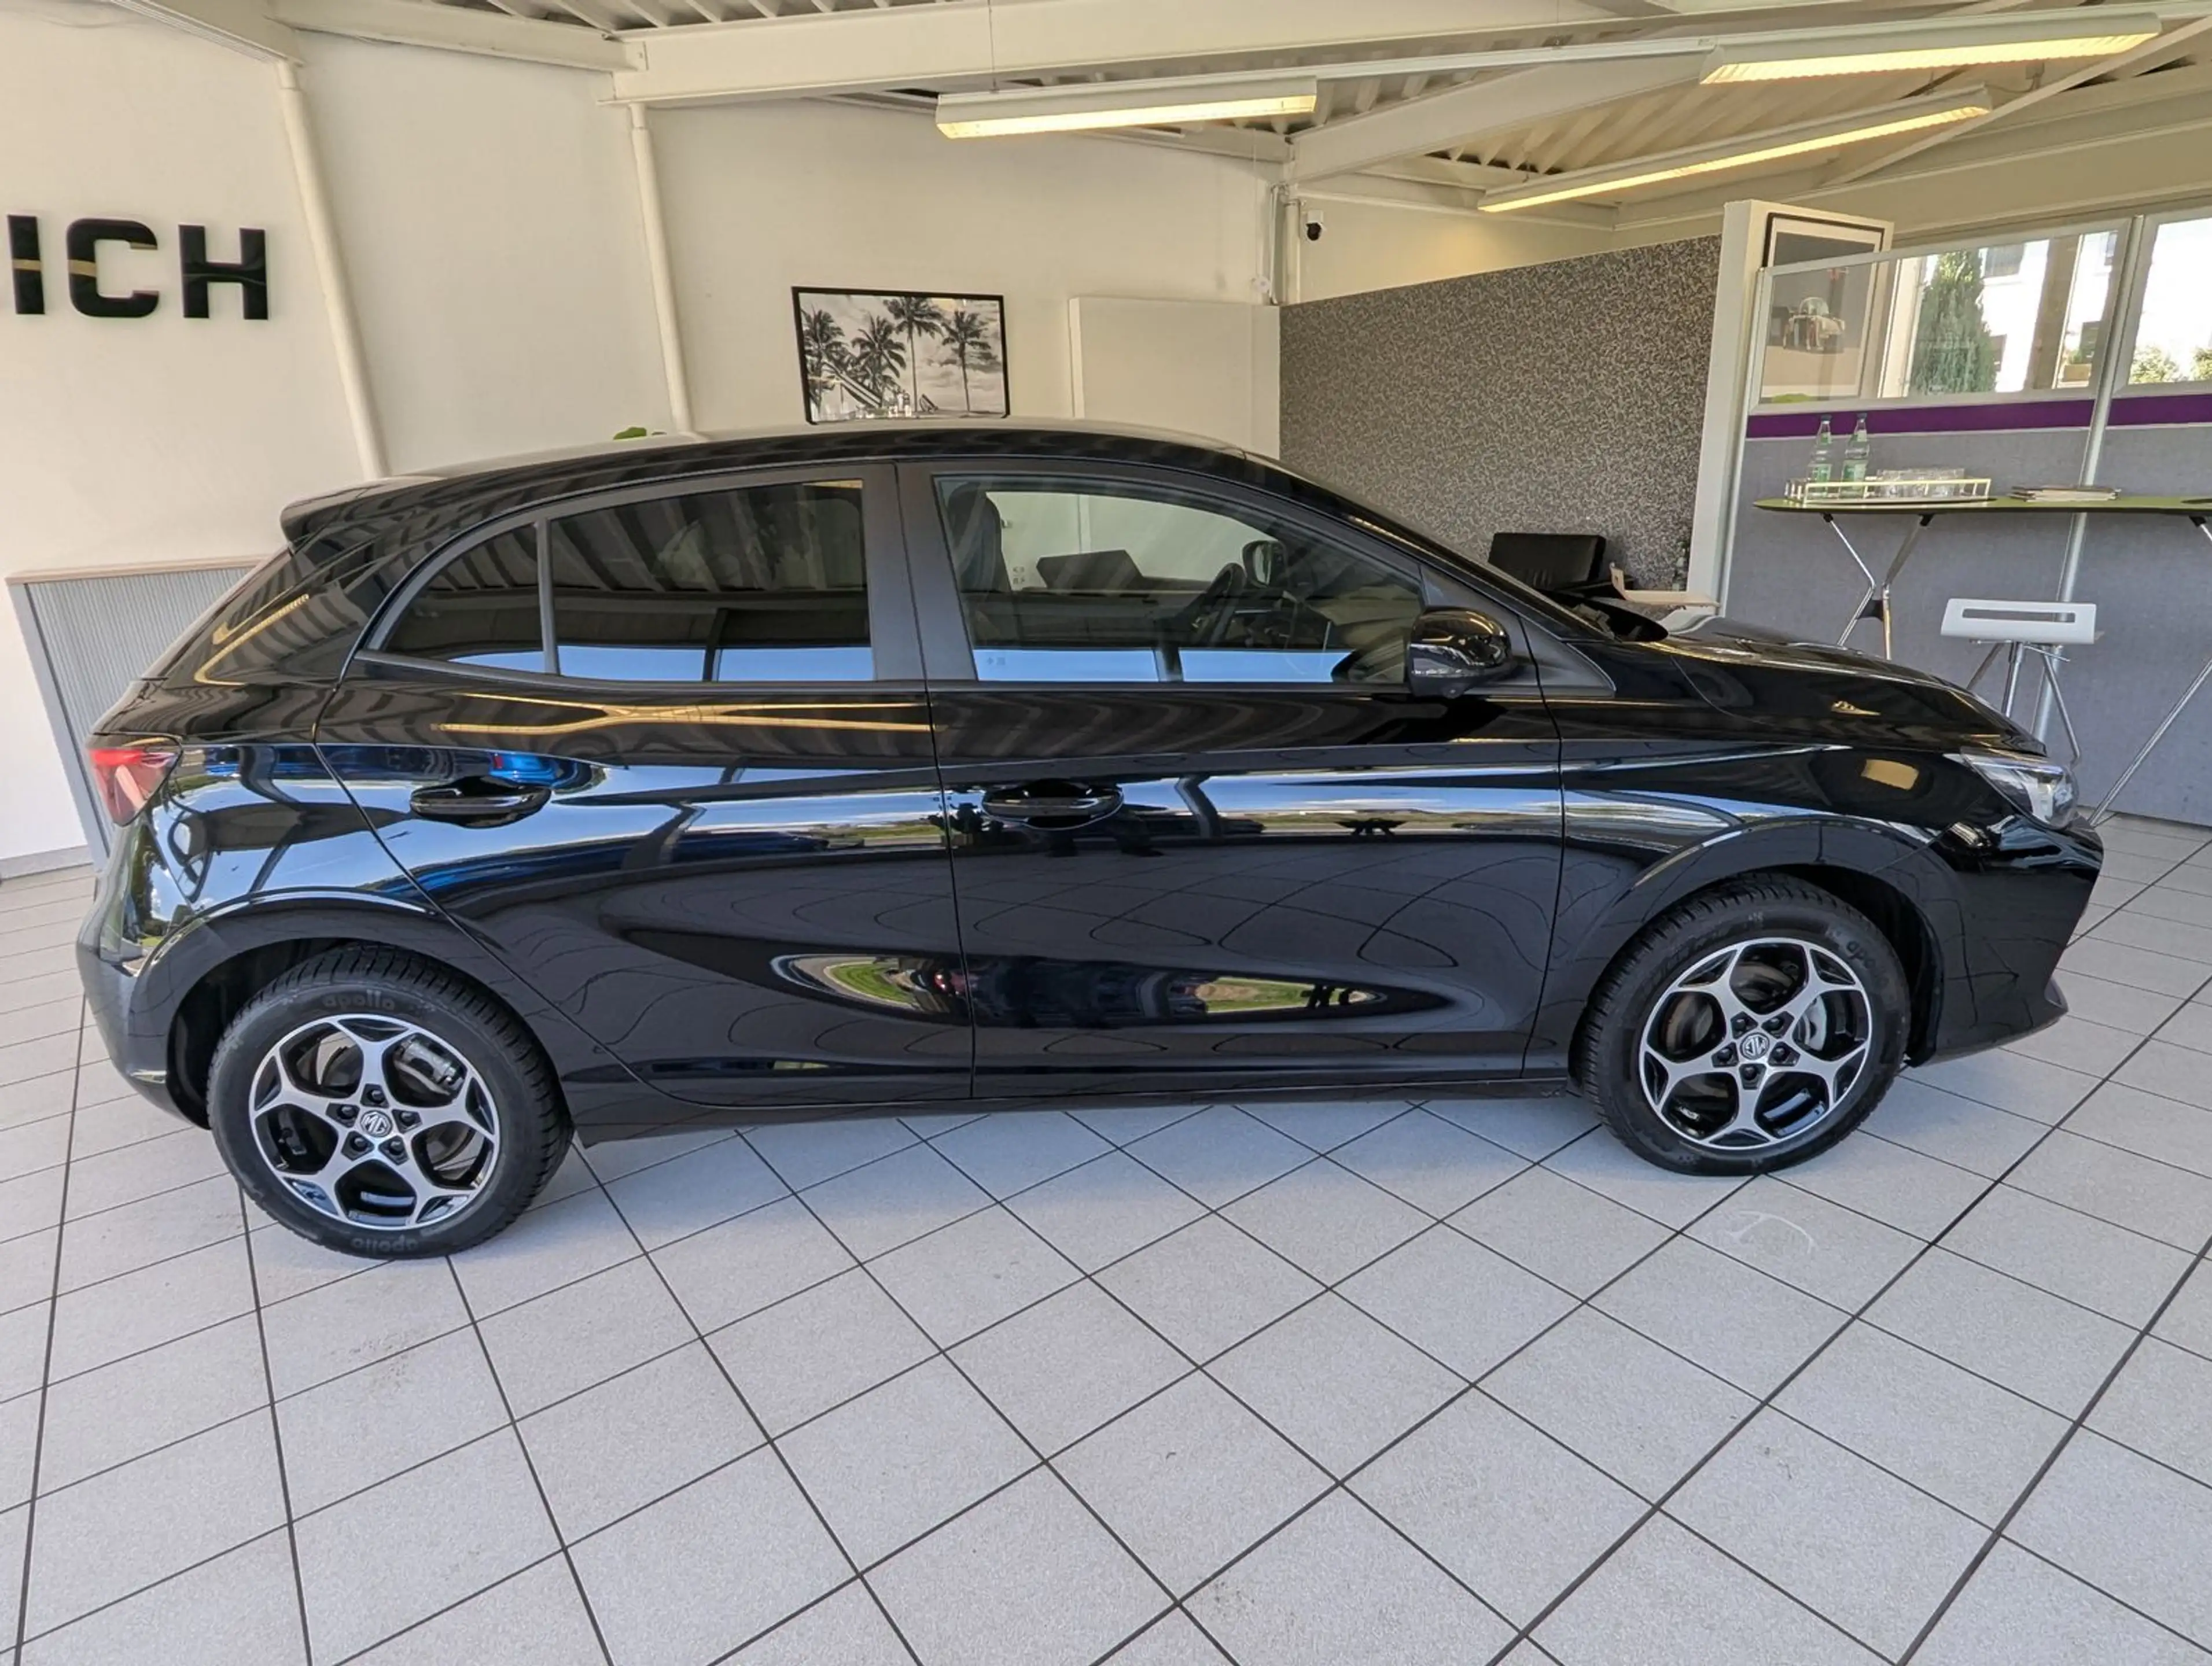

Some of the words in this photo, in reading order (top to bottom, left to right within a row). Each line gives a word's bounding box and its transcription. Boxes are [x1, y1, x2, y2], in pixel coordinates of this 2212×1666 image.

[8, 215, 268, 320] ICH
[322, 989, 395, 1012] apollo
[1744, 1035, 1767, 1057] MG
[360, 1112, 388, 1135] MG
[350, 1234, 418, 1255] apollo
